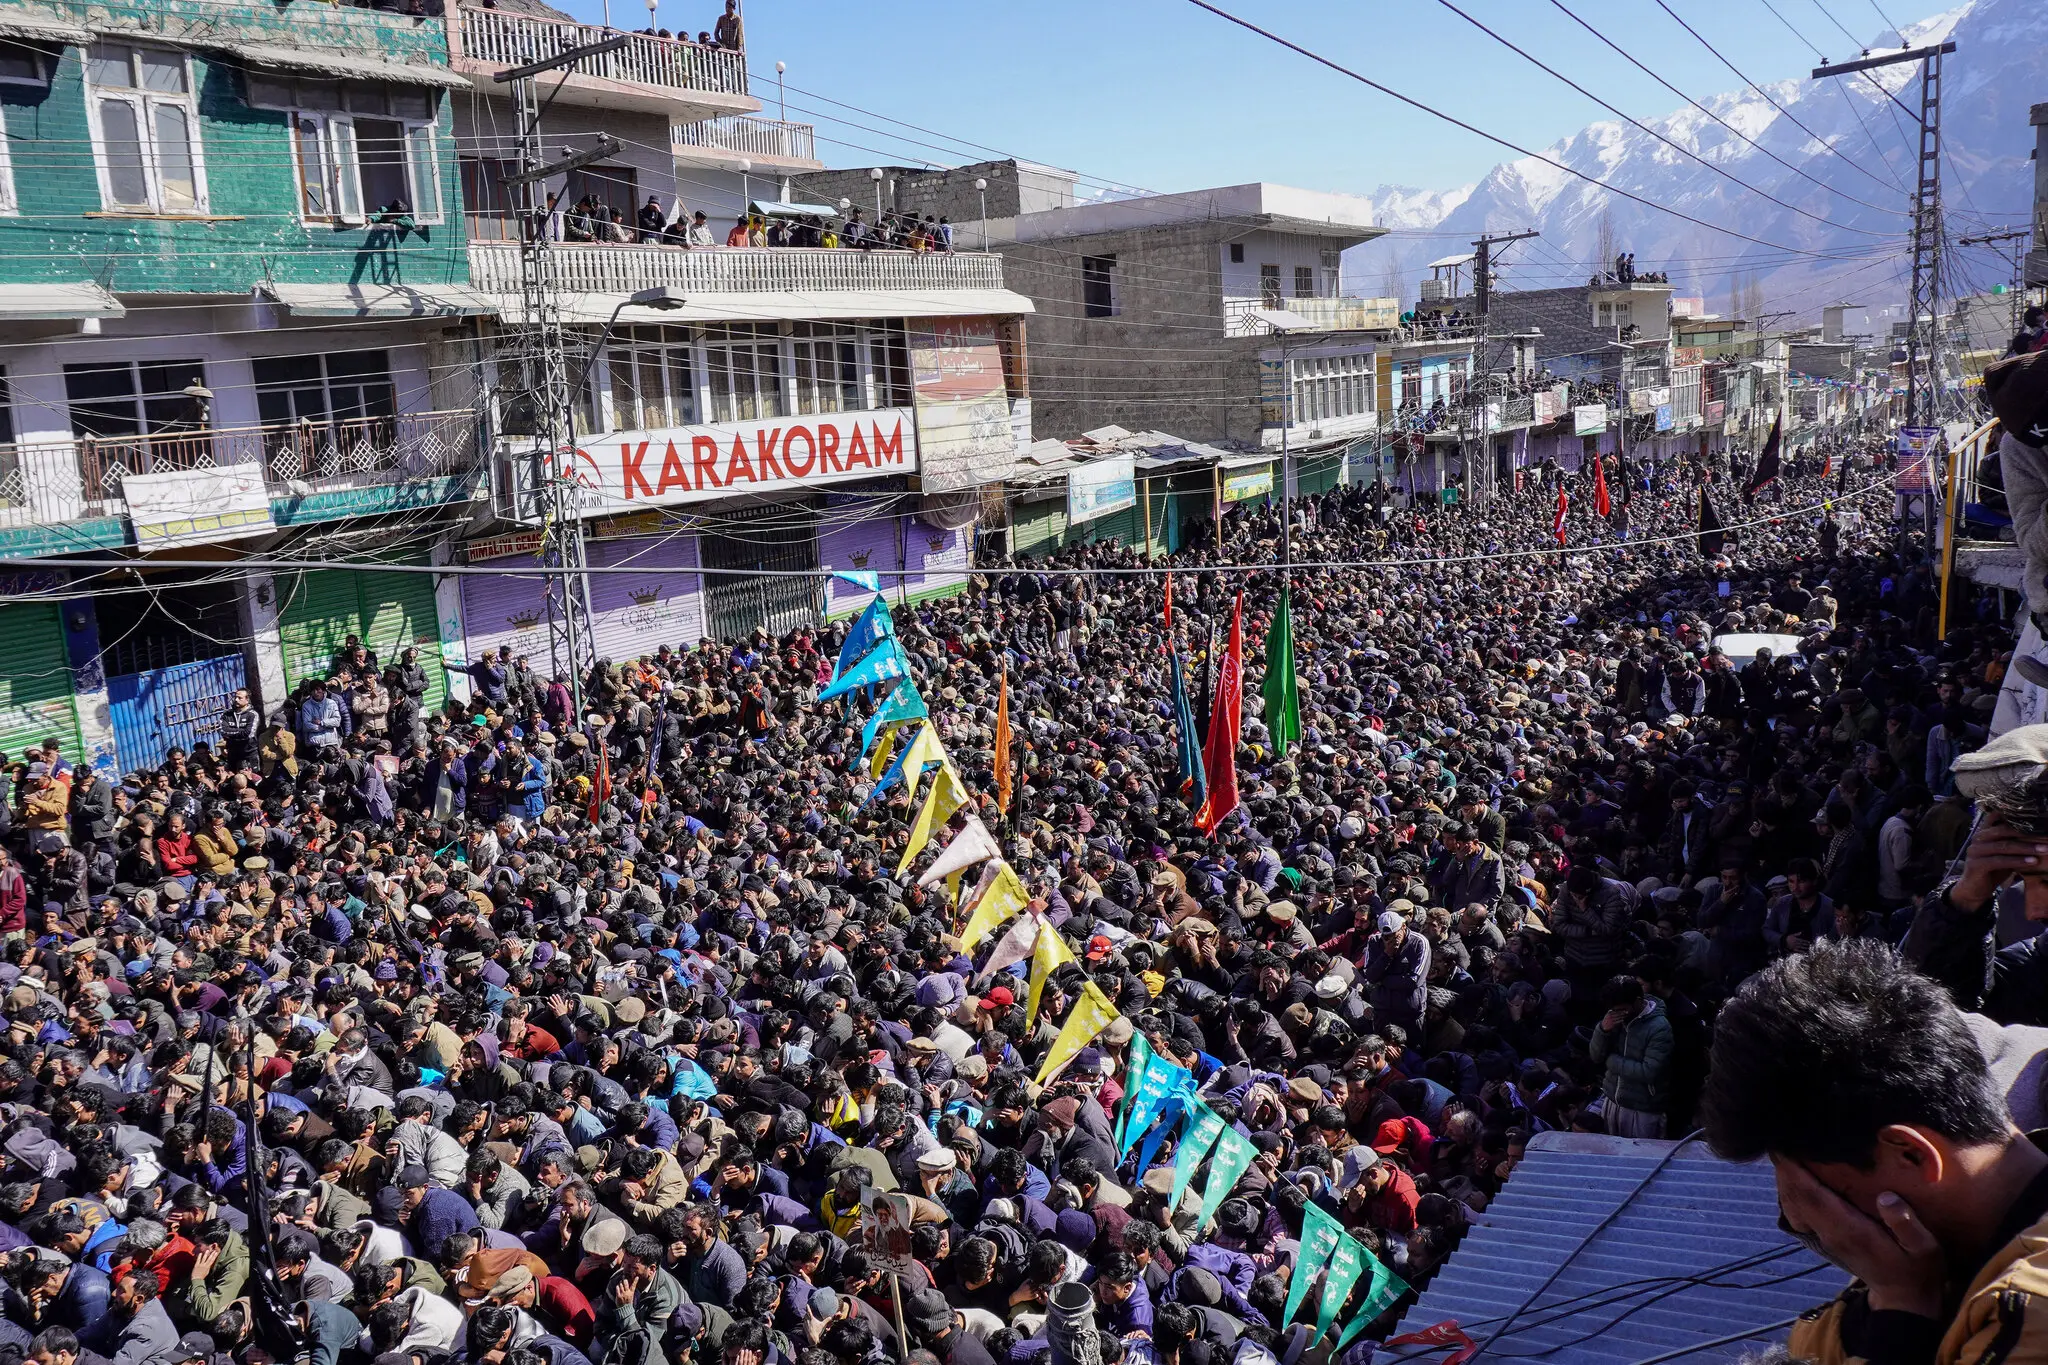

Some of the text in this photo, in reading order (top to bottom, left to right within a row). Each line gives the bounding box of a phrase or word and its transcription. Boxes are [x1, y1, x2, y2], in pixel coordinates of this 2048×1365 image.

[621, 416, 903, 499] KARAKORAM
[588, 495, 602, 508] INN
[468, 538, 513, 561] HIMALIYA
